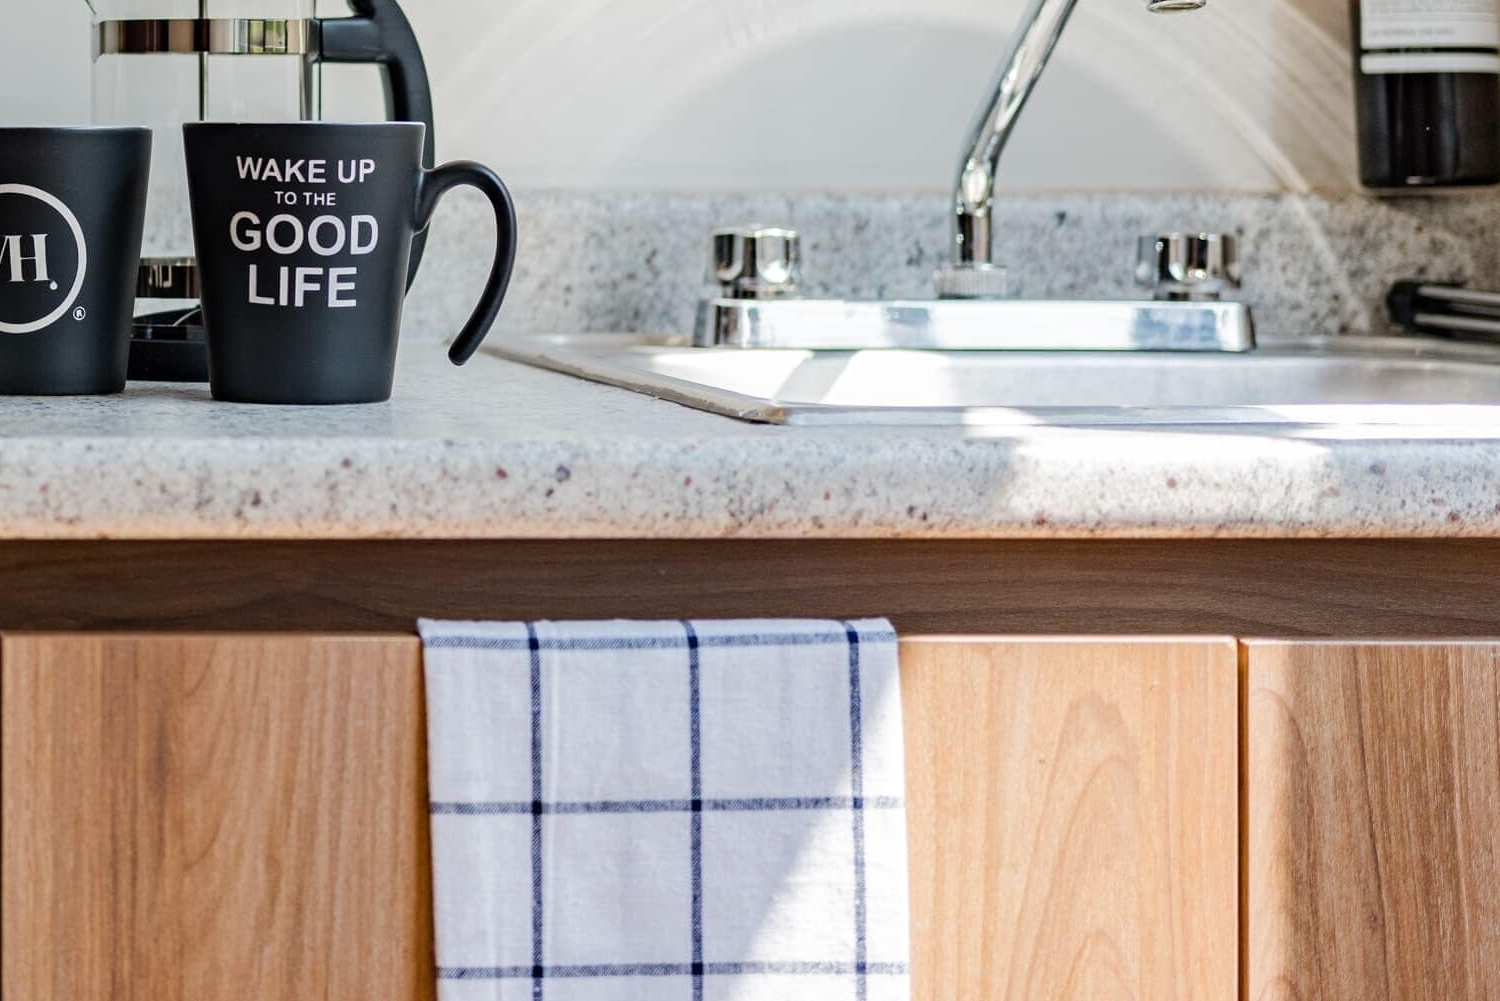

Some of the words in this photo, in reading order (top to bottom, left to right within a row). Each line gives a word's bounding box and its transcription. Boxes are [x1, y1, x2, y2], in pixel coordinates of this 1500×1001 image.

[236, 155, 327, 184] WAKE
[337, 158, 376, 184] UP
[274, 190, 297, 205] TO
[302, 191, 337, 206] THE
[230, 211, 379, 257] GOOD
[248, 264, 358, 308] LIFE
